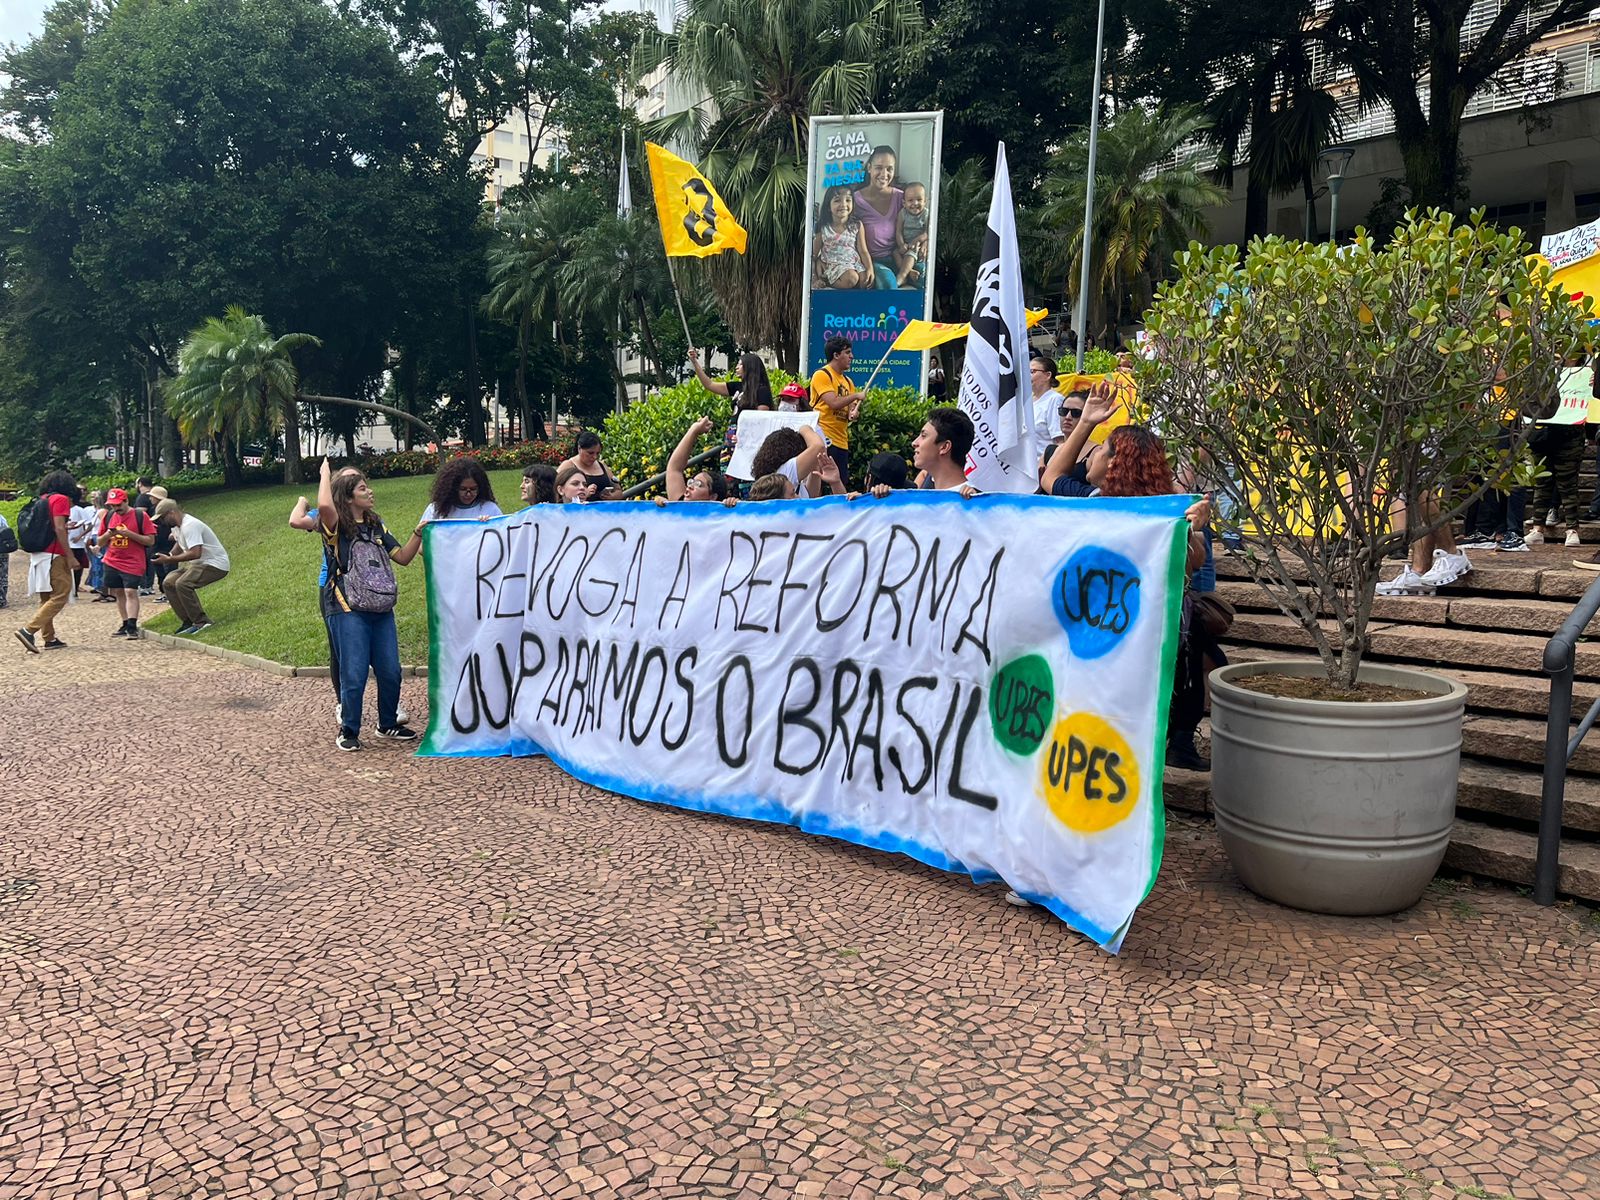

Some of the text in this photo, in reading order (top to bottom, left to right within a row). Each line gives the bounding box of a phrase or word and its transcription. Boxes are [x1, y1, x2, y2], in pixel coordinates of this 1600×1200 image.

[825, 143, 875, 160] CONTA,
[827, 131, 866, 147] TÁ NA
[823, 330, 899, 342] CAMPINA
[824, 313, 876, 329] Renda
[960, 386, 982, 422] NSINO
[978, 422, 1012, 475] OFICAL
[971, 384, 992, 410] DOS
[476, 522, 1006, 667] REVOGA A REFORMA
[1061, 563, 1141, 634] UCES
[451, 631, 998, 811] OU PARAMOS O BRASIL
[997, 675, 1055, 743] UBES
[1047, 734, 1127, 803] UPES
